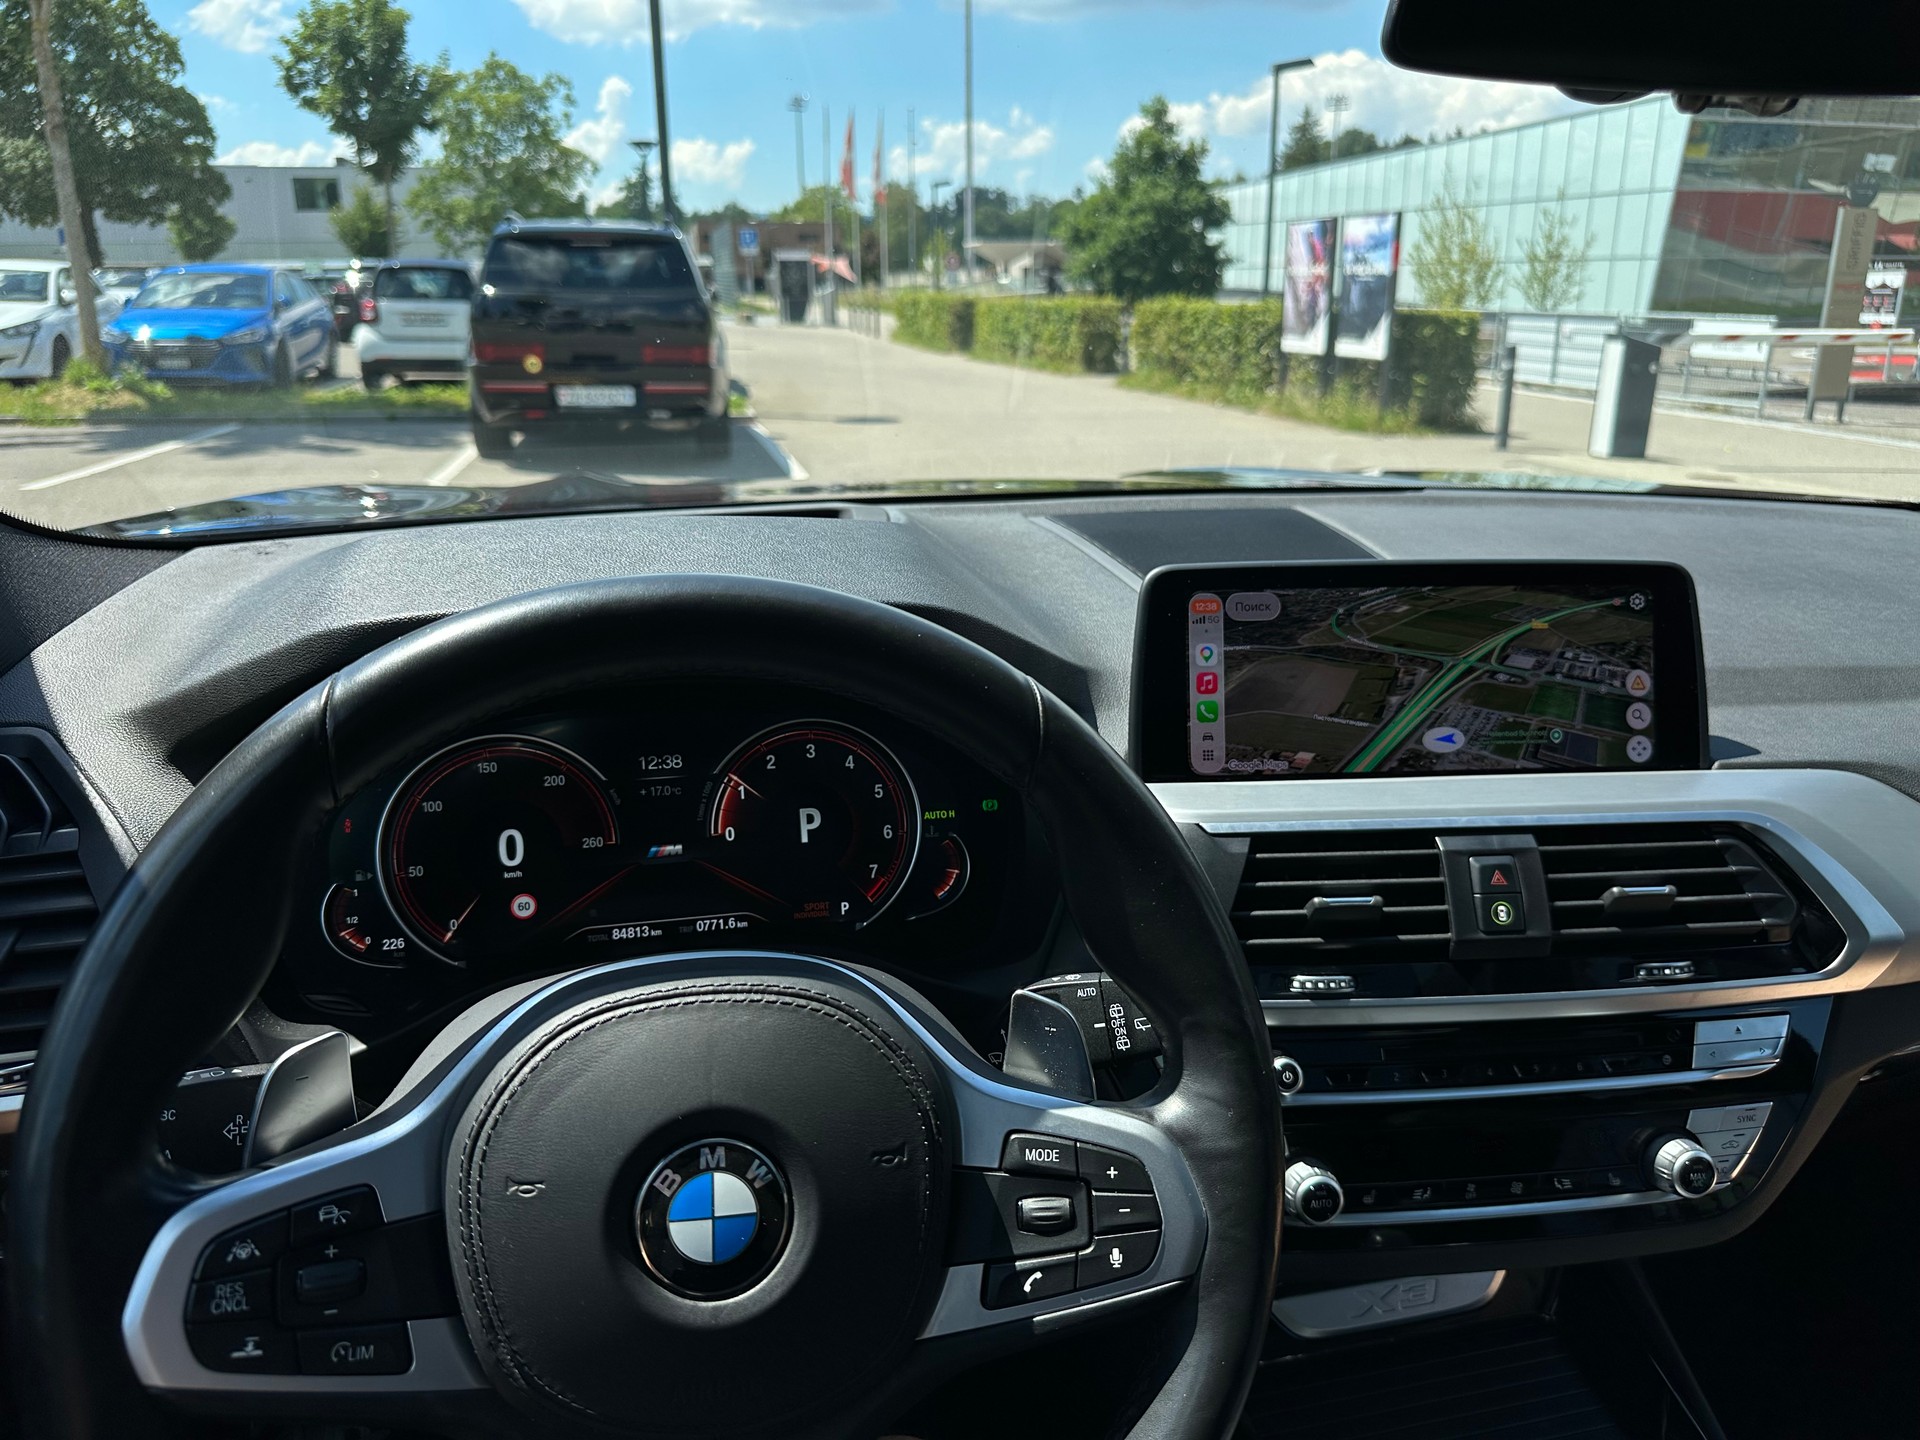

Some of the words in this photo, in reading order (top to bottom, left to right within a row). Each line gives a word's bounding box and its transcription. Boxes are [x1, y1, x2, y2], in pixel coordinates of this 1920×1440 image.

[1194, 602, 1217, 611] 12:38
[1235, 601, 1272, 612] Поиск
[1207, 616, 1219, 624] 5G
[806, 744, 817, 758] 3
[477, 762, 498, 774] 150
[638, 754, 683, 771] 12:38
[766, 755, 777, 770] 2
[845, 755, 856, 769] 4
[1228, 759, 1262, 772] Google
[1263, 759, 1289, 771] Maps
[543, 775, 566, 787] 200
[738, 785, 746, 800] 1
[874, 785, 884, 798] 5
[422, 800, 443, 813] 100
[924, 811, 945, 820] AUTO
[948, 810, 956, 818] H
[799, 808, 822, 843] P
[883, 825, 893, 839] 6
[725, 827, 736, 842] 0
[498, 828, 525, 867] 0
[582, 836, 604, 849] 260
[408, 866, 424, 878] 50
[504, 870, 522, 879] km/h
[869, 864, 879, 879] 7
[518, 902, 531, 912] 60
[803, 901, 830, 912] SPORT
[840, 901, 850, 916] P
[345, 916, 359, 925] 1/2
[793, 910, 830, 920] INDIVIDUAL
[449, 919, 458, 931] 0
[695, 918, 736, 932] 0771.6
[736, 920, 749, 928] km
[611, 926, 650, 941] 84813
[650, 928, 663, 937] km
[365, 936, 372, 945] 0
[382, 938, 405, 951] 226
[1077, 987, 1097, 998] AUTO
[1111, 1019, 1126, 1028] OFF
[1114, 1027, 1127, 1036] ON
[236, 1114, 244, 1125] R
[1737, 1114, 1757, 1123] SYNC
[236, 1135, 243, 1146] L
[1025, 1148, 1060, 1163] MODE
[653, 1146, 773, 1198] BMW
[1690, 1172, 1706, 1181] MAX
[1310, 1199, 1333, 1209] AUTO
[215, 1281, 245, 1298] RES
[1351, 1278, 1440, 1319] X3
[210, 1296, 252, 1316] CNCL
[348, 1344, 375, 1362] LIM
